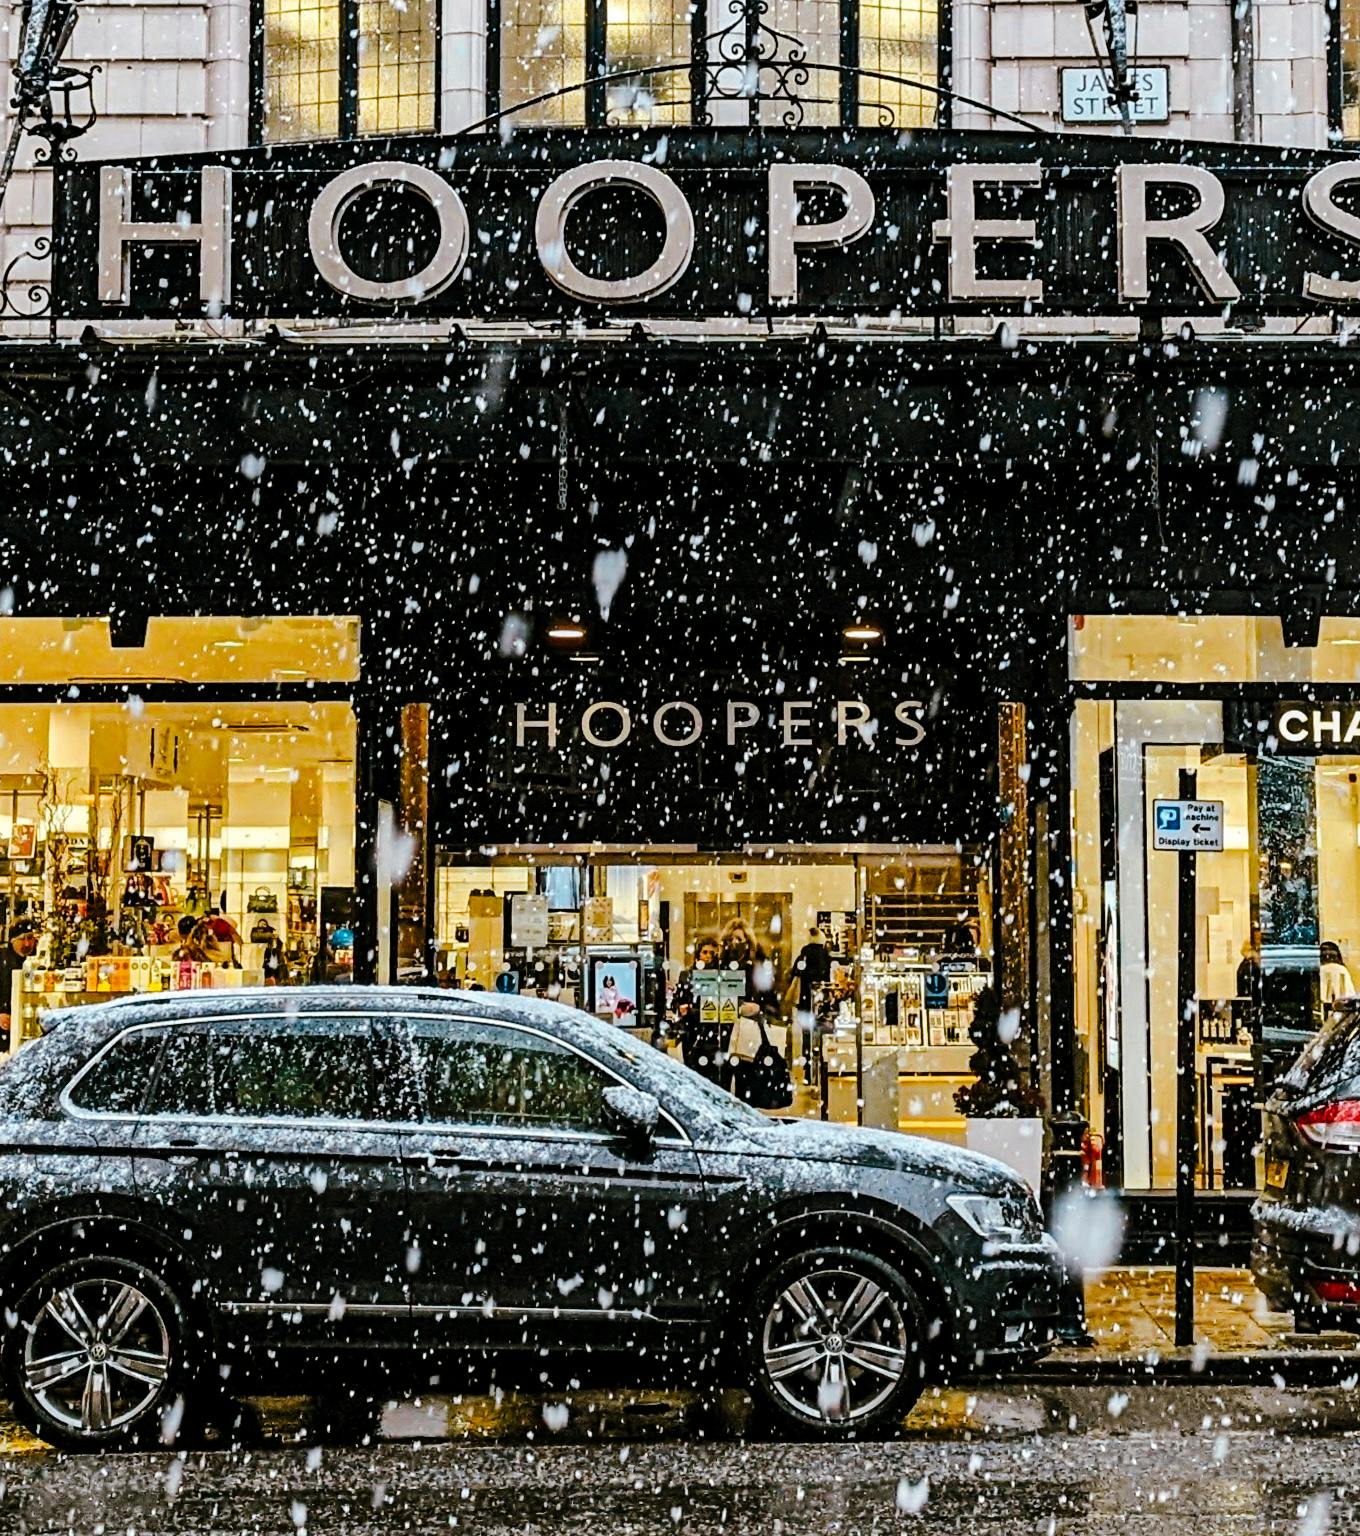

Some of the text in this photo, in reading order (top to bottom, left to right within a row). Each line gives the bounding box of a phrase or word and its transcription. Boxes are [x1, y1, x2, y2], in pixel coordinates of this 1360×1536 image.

[1077, 73, 1153, 92] JAES
[1073, 97, 1159, 115] STRET
[516, 701, 927, 747] HOOPERS
[1187, 804, 1203, 813] Pay
[1158, 837, 1219, 847] Display ticket
